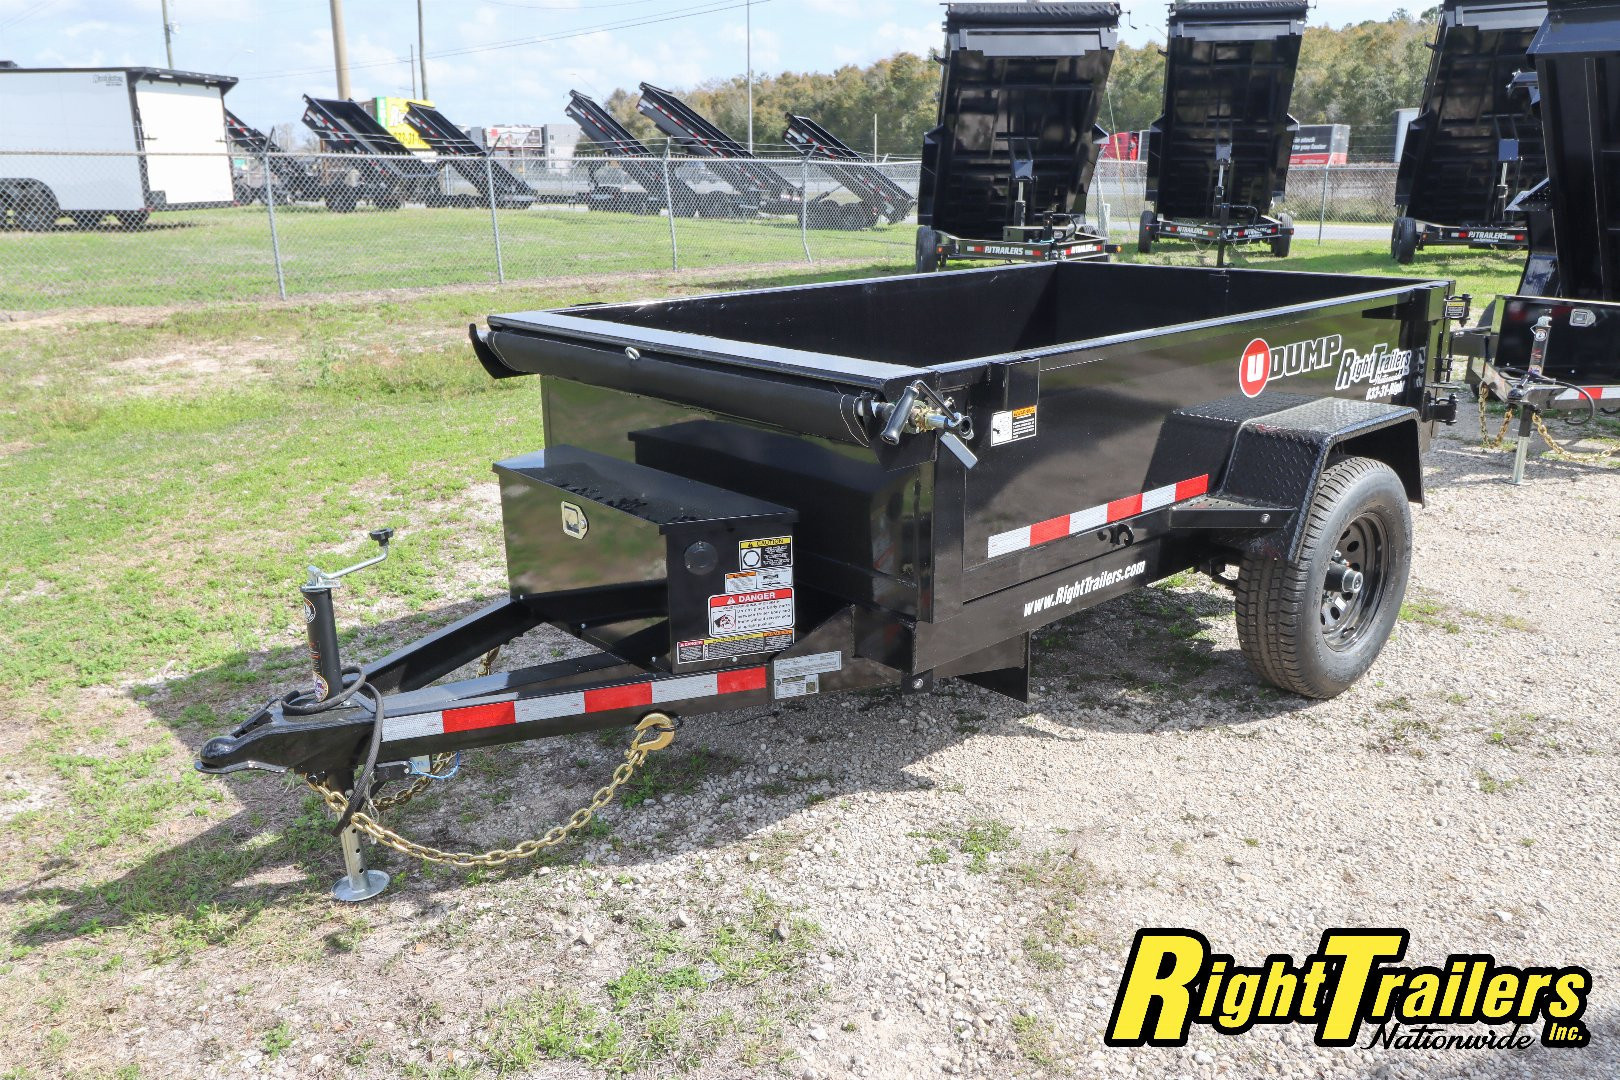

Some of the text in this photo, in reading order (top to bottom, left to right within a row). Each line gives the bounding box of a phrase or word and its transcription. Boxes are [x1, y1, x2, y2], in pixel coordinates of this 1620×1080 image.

[756, 538, 784, 548] CAUTION
[1023, 560, 1146, 617] www.RightTrailers.com
[738, 592, 776, 604] DANGER
